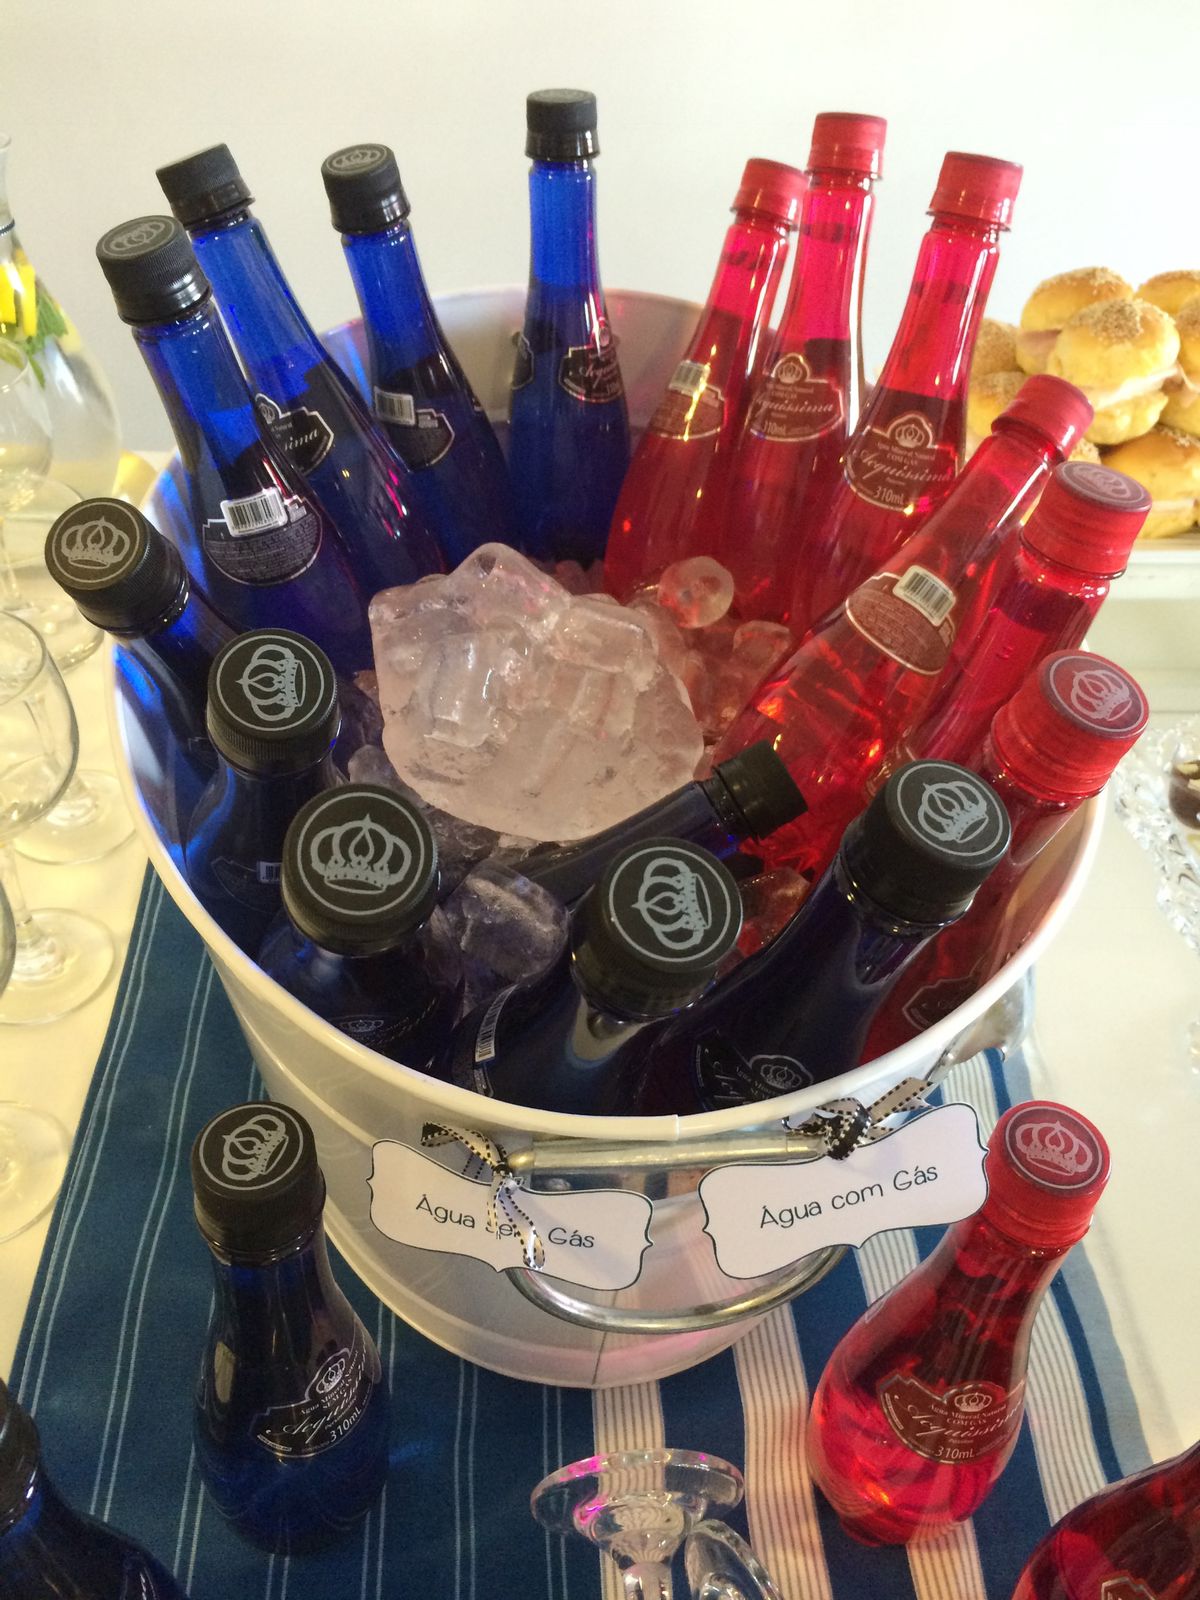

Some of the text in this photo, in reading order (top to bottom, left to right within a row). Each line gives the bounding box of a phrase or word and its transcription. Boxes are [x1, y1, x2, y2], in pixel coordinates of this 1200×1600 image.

[873, 486, 904, 505] 310mL
[759, 1165, 938, 1229] Água com Gás
[415, 1193, 476, 1229] Água
[547, 1227, 595, 1248] Gás
[329, 1407, 362, 1442] 310mL
[935, 1445, 975, 1460] 310mL
